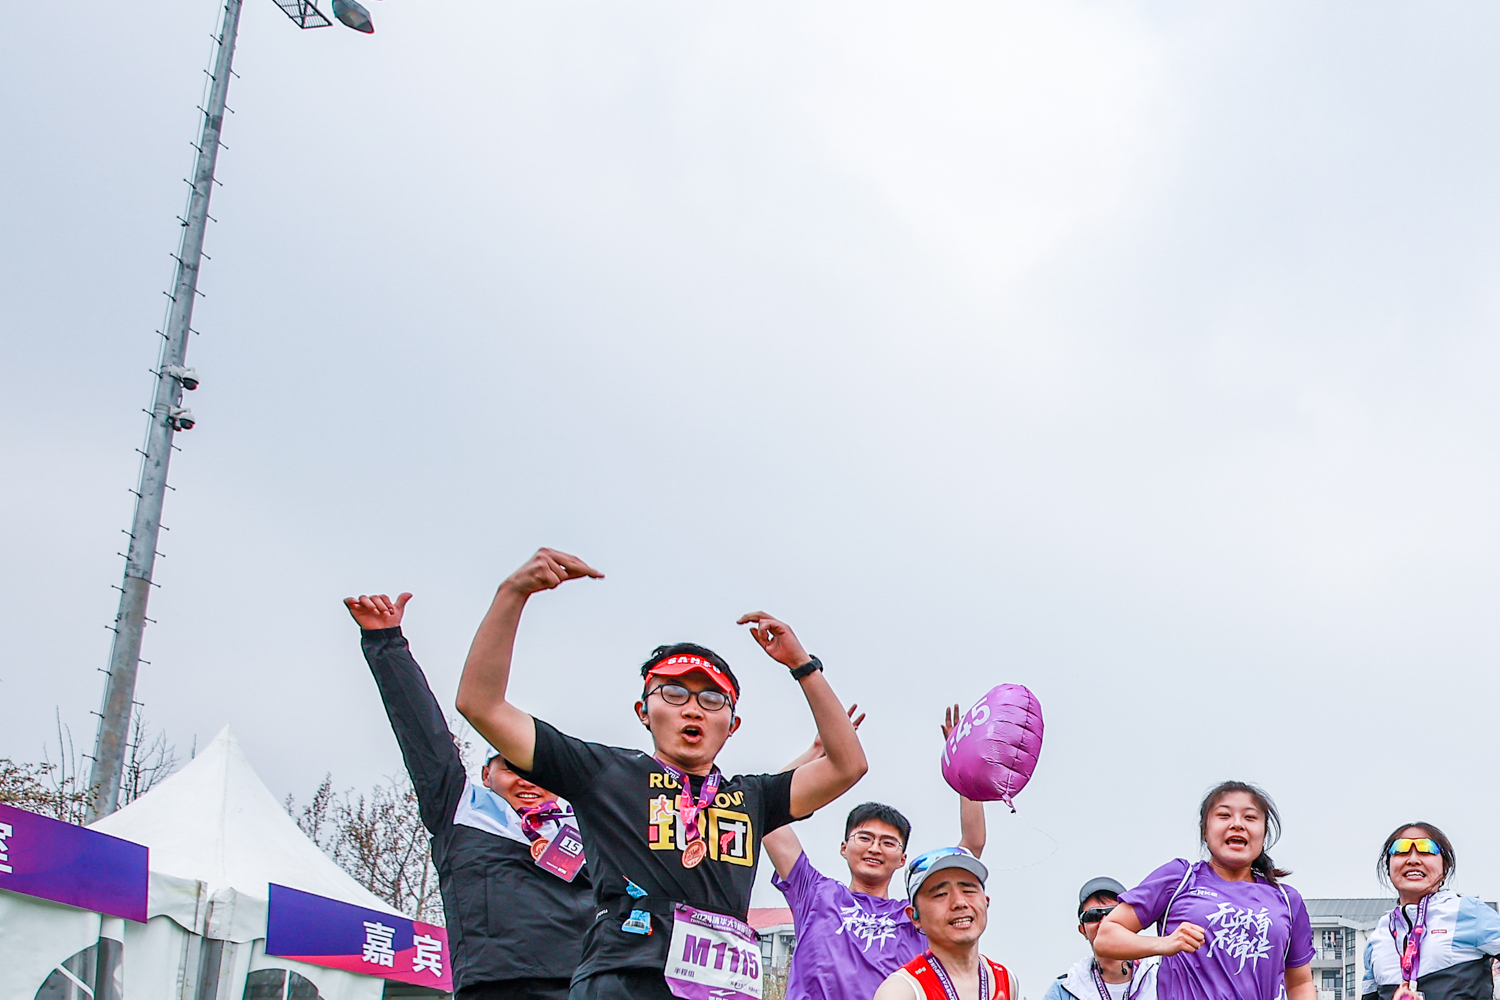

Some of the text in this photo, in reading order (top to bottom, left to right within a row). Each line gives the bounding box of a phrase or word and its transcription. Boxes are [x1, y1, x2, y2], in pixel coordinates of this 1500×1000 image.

[564, 839, 580, 852] 15
[361, 920, 443, 978] 嘉宾
[682, 933, 759, 980] M1115
